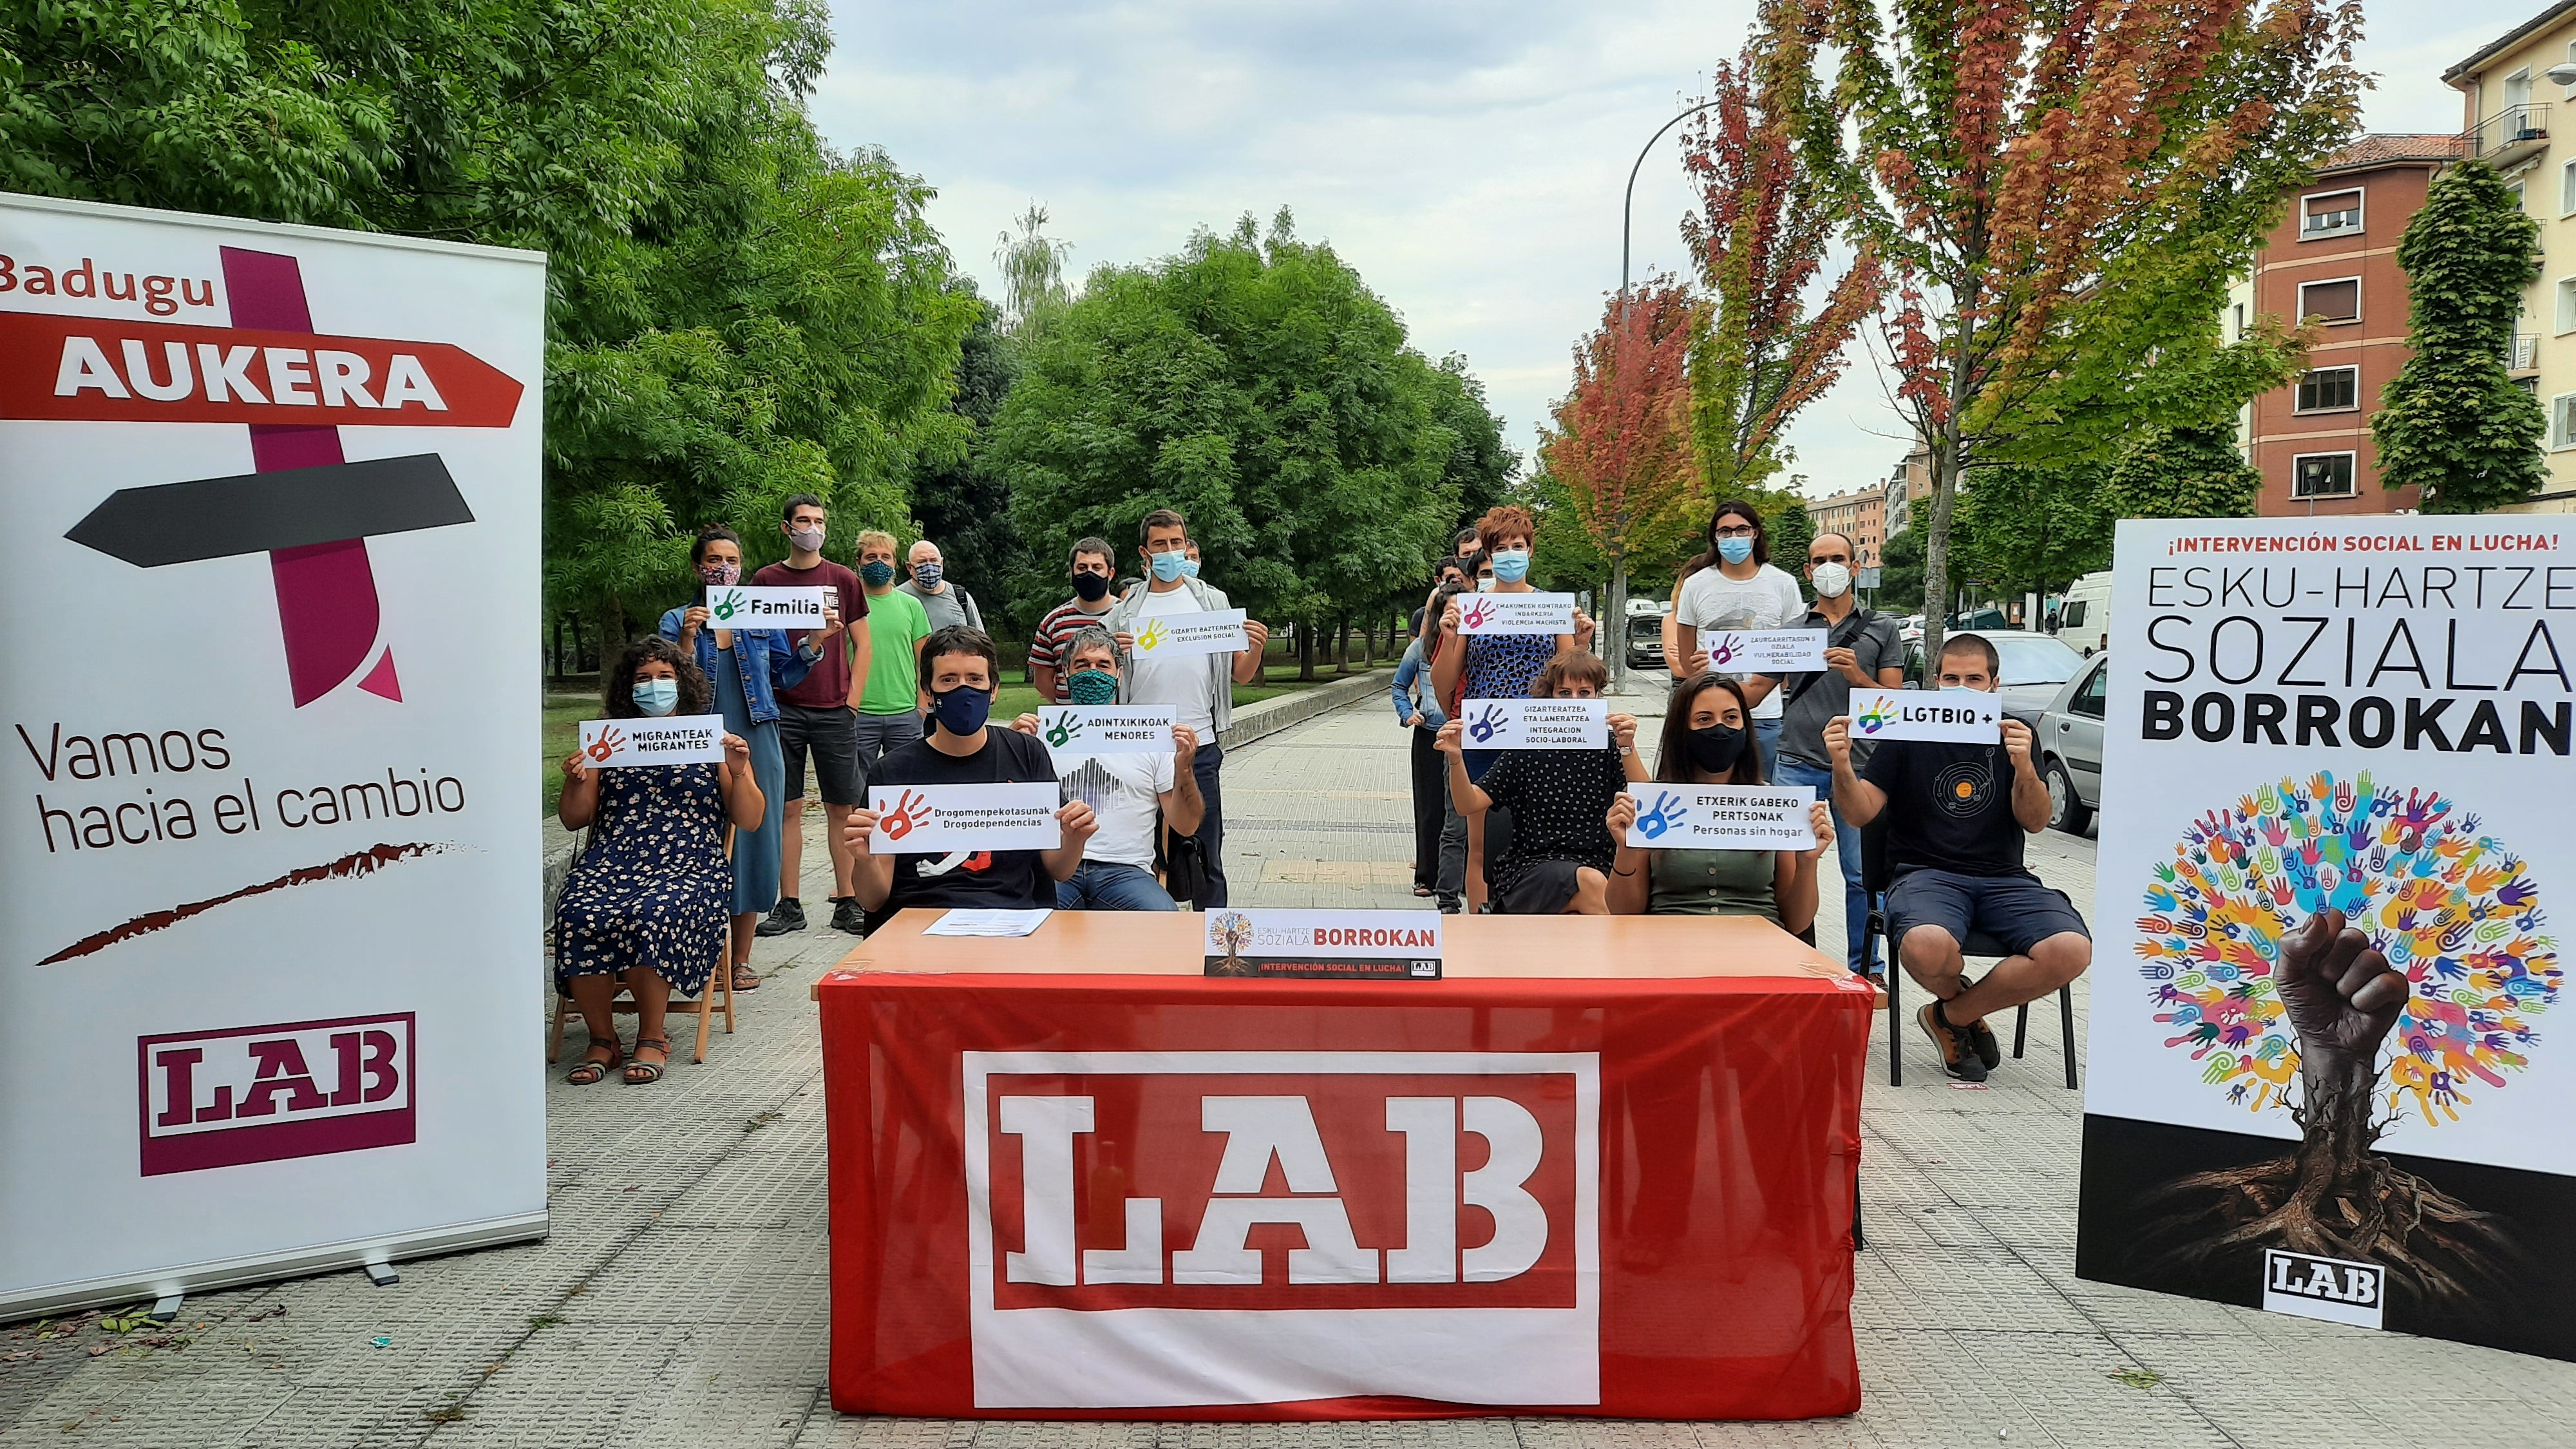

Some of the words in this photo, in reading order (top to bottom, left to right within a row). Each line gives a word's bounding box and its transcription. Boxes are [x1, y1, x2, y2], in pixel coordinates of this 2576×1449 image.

[53, 336, 448, 411] AUKERA
[2168, 532, 2336, 556] ¡INTERVENCIÓN
[2343, 535, 2425, 552] SOCIAL
[2432, 535, 2463, 550] EN
[2470, 534, 2560, 551] LUCHA!
[2148, 567, 2576, 611] ESKU-HARTZE
[751, 600, 819, 614] Familia
[1199, 624, 1240, 632] BAZTERKETA
[2144, 615, 2573, 693] SOZIALA
[1087, 717, 1170, 728] ADINTXIKIKOAK
[1902, 706, 1975, 725] LGTBIQ
[2141, 690, 2573, 756] BORROKAN
[632, 728, 714, 742] MIGRANTEAK
[1104, 731, 1155, 741] MENORES
[15, 722, 231, 781] Vamos
[637, 740, 710, 752] MIGRANTES
[1696, 796, 1747, 806] ETXERIK
[1750, 797, 1799, 808] GABEKO
[35, 790, 197, 853] hacia
[214, 778, 260, 835] el
[276, 767, 465, 828] cambio
[934, 806, 1050, 820] Drogomenpekotasunak
[1712, 811, 1784, 822] PERTSONAK
[943, 818, 1042, 831] Drogodependencias
[1693, 825, 1747, 837] Personas
[1749, 826, 1766, 836] sin
[1770, 826, 1803, 838] hogar
[1257, 934, 1311, 946] SOZIALA
[1314, 928, 1434, 947] BORROKAN
[1258, 961, 1324, 972] ¡INTERVENCIÓN
[1326, 963, 1358, 972] SOCIAL
[1412, 962, 1434, 971] LAB
[156, 1030, 398, 1127] LAB
[999, 1095, 1549, 1285] LAB
[2272, 1256, 2376, 1303] LAB
